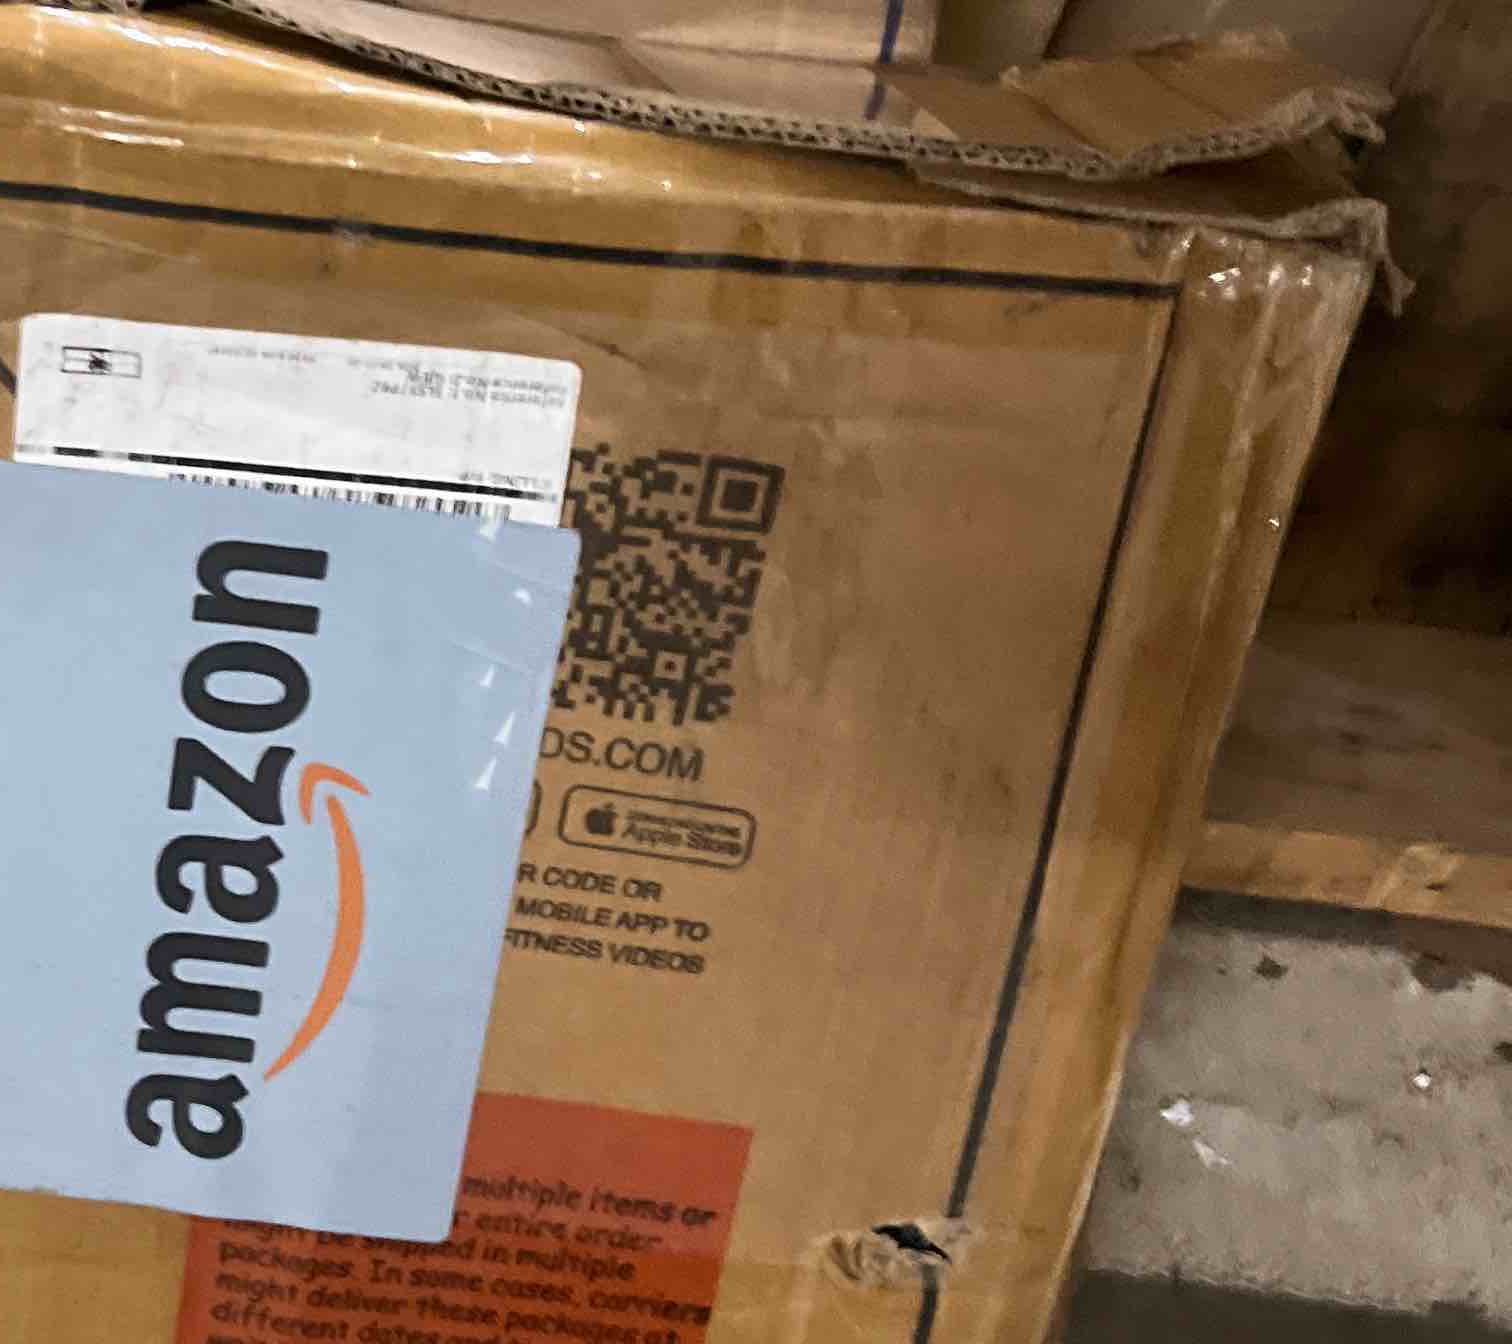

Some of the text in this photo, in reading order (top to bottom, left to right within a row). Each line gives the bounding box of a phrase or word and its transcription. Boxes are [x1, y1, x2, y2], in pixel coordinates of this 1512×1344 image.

[124, 537, 330, 1162] amazon
[542, 865, 616, 895] CODE
[622, 876, 663, 903] OR
[514, 896, 711, 943] MOBILE APP TO
[607, 942, 706, 975] VIDEOS
[370, 1258, 403, 1284] In
[409, 1267, 484, 1292] some
[515, 1248, 636, 1281] multiple
[209, 1299, 350, 1342] different
[307, 1283, 408, 1316] deliver
[416, 1296, 498, 1325] these
